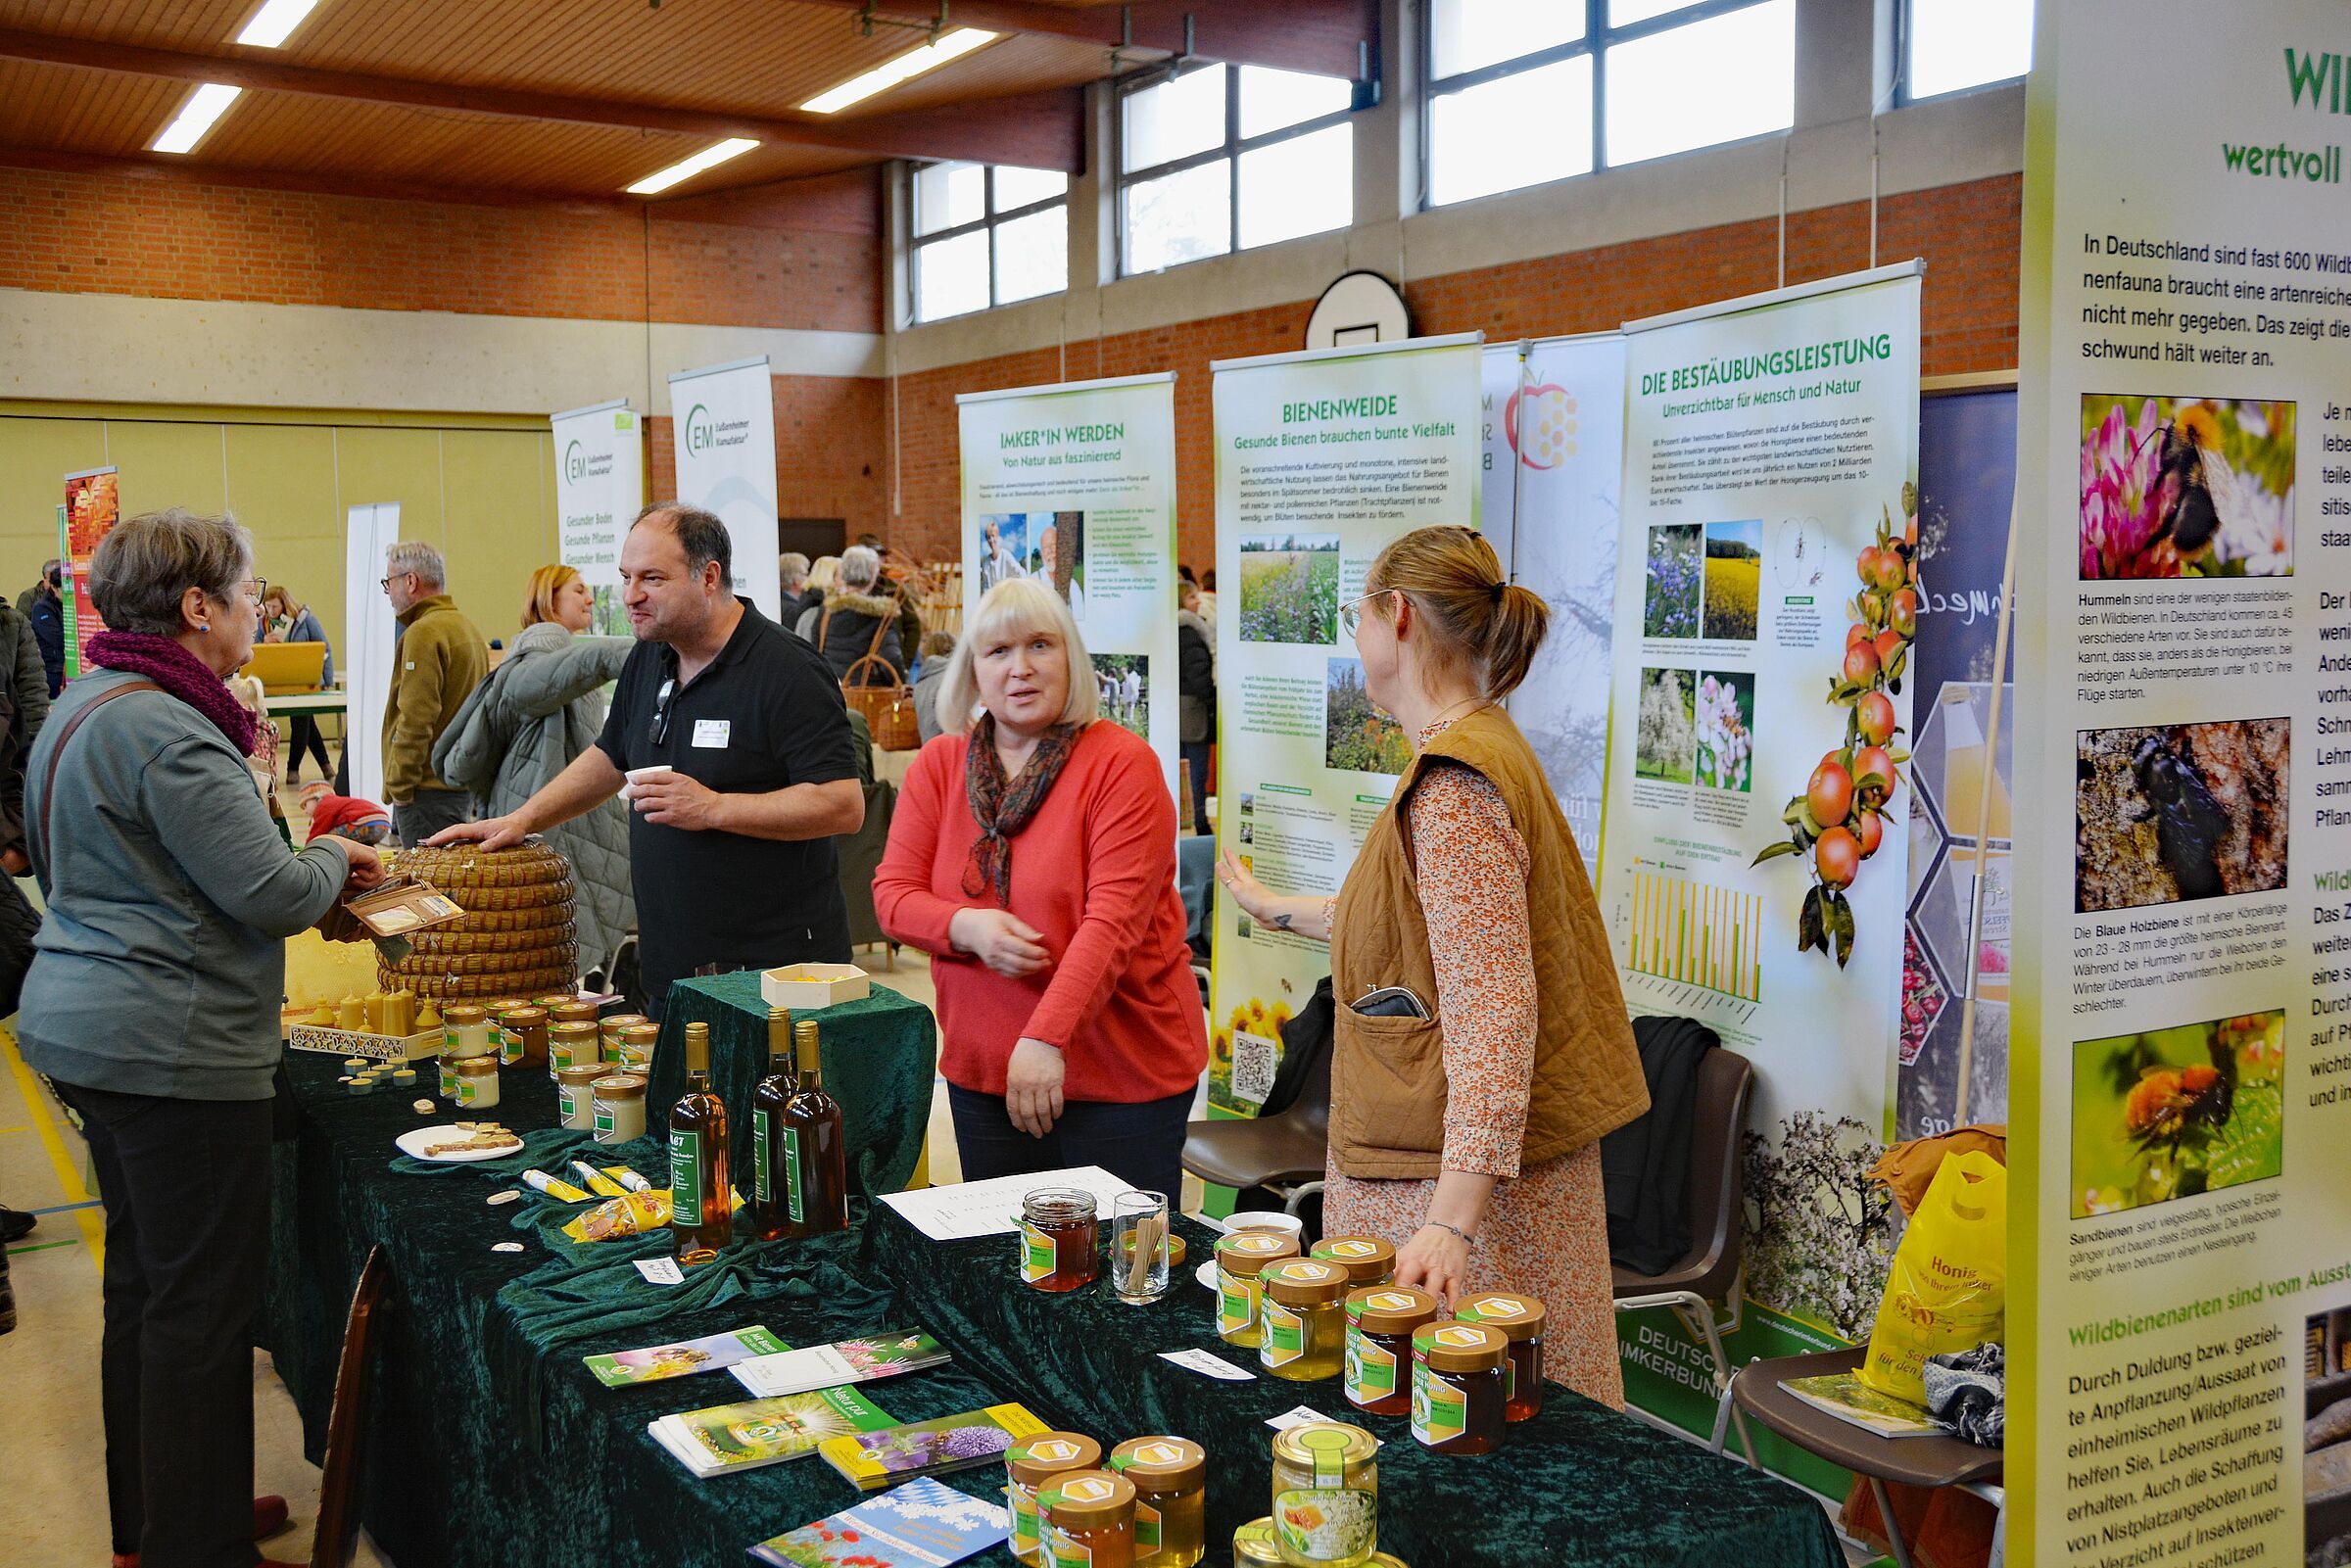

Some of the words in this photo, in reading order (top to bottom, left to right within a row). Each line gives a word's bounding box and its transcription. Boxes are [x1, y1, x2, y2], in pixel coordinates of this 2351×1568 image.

[2222, 143, 2340, 184] wertvoll
[2086, 234, 2099, 254] In
[2107, 236, 2209, 261] Deutschland
[2215, 246, 2246, 265] sind
[2252, 249, 2279, 268] fast
[2284, 252, 2310, 270] 600
[2084, 271, 2162, 292] nenfauna
[2169, 275, 2229, 297] braucht
[2234, 281, 2265, 300] eine
[2084, 305, 2126, 324] nicht
[2132, 308, 2174, 327] mehr
[2180, 312, 2250, 334] gegeben.
[2257, 314, 2284, 334] Das
[2289, 318, 2325, 341] zeigt
[2329, 320, 2350, 338] die
[1643, 372, 1666, 396] DIE
[1672, 334, 1890, 391] BESTÄUBUNGSLEISTUNG
[2083, 340, 2159, 360] schwund
[2166, 343, 2194, 362] hält
[2200, 346, 2247, 364] weiter
[2252, 352, 2273, 366] an.
[1282, 395, 1397, 423] BIENENWEIDE
[1663, 397, 1734, 418] Unverzichtbar
[1738, 393, 1751, 407] für
[1753, 387, 1795, 405] Mensch
[1799, 384, 1821, 399] und
[1826, 380, 1861, 396] Natur
[2324, 402, 2340, 420] Je
[694, 424, 714, 450] EM
[1065, 420, 1124, 443] WERDEN
[1234, 435, 1278, 450] Gesunde
[1281, 433, 1317, 446] Bienen
[1320, 429, 1370, 444] brauchen
[1375, 427, 1409, 440] bunte
[1413, 422, 1455, 437] Vielfalt
[1823, 431, 1867, 441] bedeutenden
[571, 458, 587, 479] EM
[1003, 457, 1020, 468] Von
[1021, 455, 1045, 466] Natur
[1048, 455, 1062, 465] aus
[1065, 450, 1121, 463] faszinierend
[2080, 594, 2131, 605] Hummeln
[2134, 594, 2153, 604] sind
[2156, 593, 2177, 604] eine
[2178, 593, 2193, 603] der
[2193, 592, 2231, 605] wenigen
[2320, 592, 2344, 610] Der
[2079, 614, 2097, 625] den
[2101, 612, 2157, 624] Wildbienen.
[2171, 610, 2226, 622] Deutschland
[2079, 632, 2144, 643] verschiedene
[2147, 631, 2173, 641] Arten
[2210, 628, 2229, 640] sind
[2079, 651, 2109, 663] kannt,
[2113, 651, 2135, 662] dass
[2078, 670, 2125, 684] niedrigen
[2130, 667, 2219, 680] Außentemperaturen
[2078, 689, 2105, 703] Flüge
[2109, 689, 2145, 699] starten.
[2314, 907, 2339, 924] Das
[2075, 927, 2090, 939] Die
[2096, 926, 2126, 936] Blaue
[2131, 919, 2179, 932] Holzbiene
[2074, 948, 2092, 957] von
[2096, 944, 2108, 955] 23
[2119, 941, 2130, 953] 28
[2133, 940, 2151, 951] mm
[2154, 937, 2167, 948] die
[2168, 933, 2198, 949] größte
[2074, 961, 2119, 976] Während
[2125, 958, 2137, 971] bei
[2143, 952, 2186, 967] Hummeln
[2074, 982, 2106, 995] Winter
[2312, 968, 2339, 985] eine
[2311, 1026, 2333, 1046] auf
[2310, 1085, 2335, 1107] und
[2070, 1224, 2133, 1246] Sandbienen
[1932, 1256, 1977, 1278] Honig
[2069, 1298, 2223, 1348] Wildbienenarten
[2228, 1283, 2263, 1309] sind
[2268, 1277, 2301, 1297] vom
[1358, 1343, 1376, 1355] HONIG
[2070, 1368, 2121, 1395] Durch
[2128, 1353, 2191, 1381] Duldung
[2197, 1343, 2230, 1361] bzw.
[2235, 1325, 2282, 1355] geziel-
[1878, 1352, 1895, 1365] für
[1896, 1361, 1917, 1376] den
[1424, 1382, 1447, 1394] HONIG
[2069, 1410, 2085, 1426] te
[2091, 1363, 2256, 1421] Anpflanzung/Aussaat
[2260, 1356, 2285, 1374] von
[830, 1387, 855, 1407] Natur
[848, 1402, 868, 1417] pur
[2068, 1415, 2185, 1458] einheimischen
[2190, 1387, 2284, 1424] Wildpflanzen
[2068, 1465, 2119, 1490] helfen
[2126, 1454, 2153, 1475] Sie,
[2160, 1423, 2261, 1464] Lebensräume
[2266, 1417, 2281, 1432] zu
[2067, 1493, 2137, 1521] erhalten.
[2143, 1475, 2181, 1500] Auch
[2185, 1468, 2207, 1488] die
[2211, 1447, 2283, 1479] Schaffung
[2067, 1535, 2096, 1552] von
[2102, 1488, 2246, 1544] Nistplatzangeboten
[2251, 1474, 2278, 1497] und
[2099, 1542, 2164, 1568] Verzicht
[2168, 1531, 2191, 1554] auf
[2197, 1507, 2284, 1544] Insektenver-
[2197, 1540, 2265, 1568] schützen
